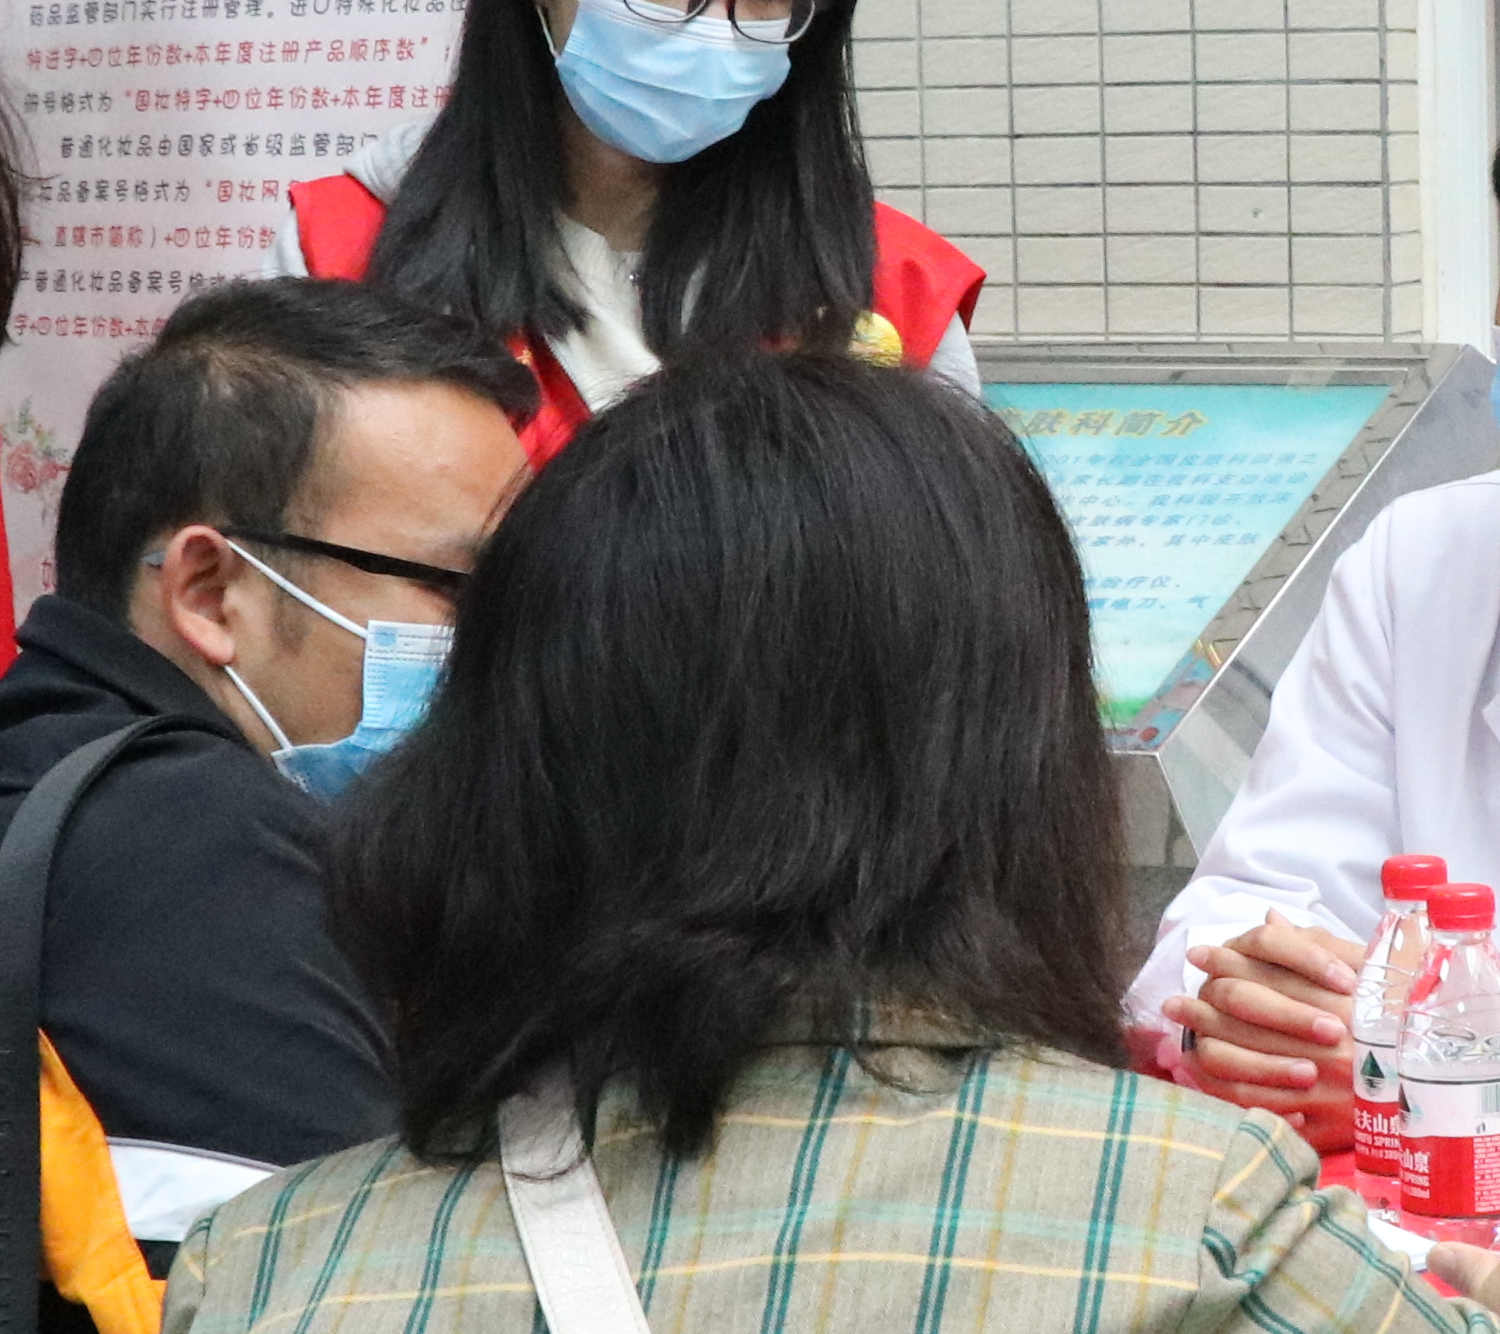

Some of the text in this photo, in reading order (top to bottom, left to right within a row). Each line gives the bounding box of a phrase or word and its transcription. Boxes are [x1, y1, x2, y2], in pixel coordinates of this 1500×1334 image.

[1010, 408, 1204, 439] 肤科简介
[1400, 1148, 1431, 1174] 山泉
